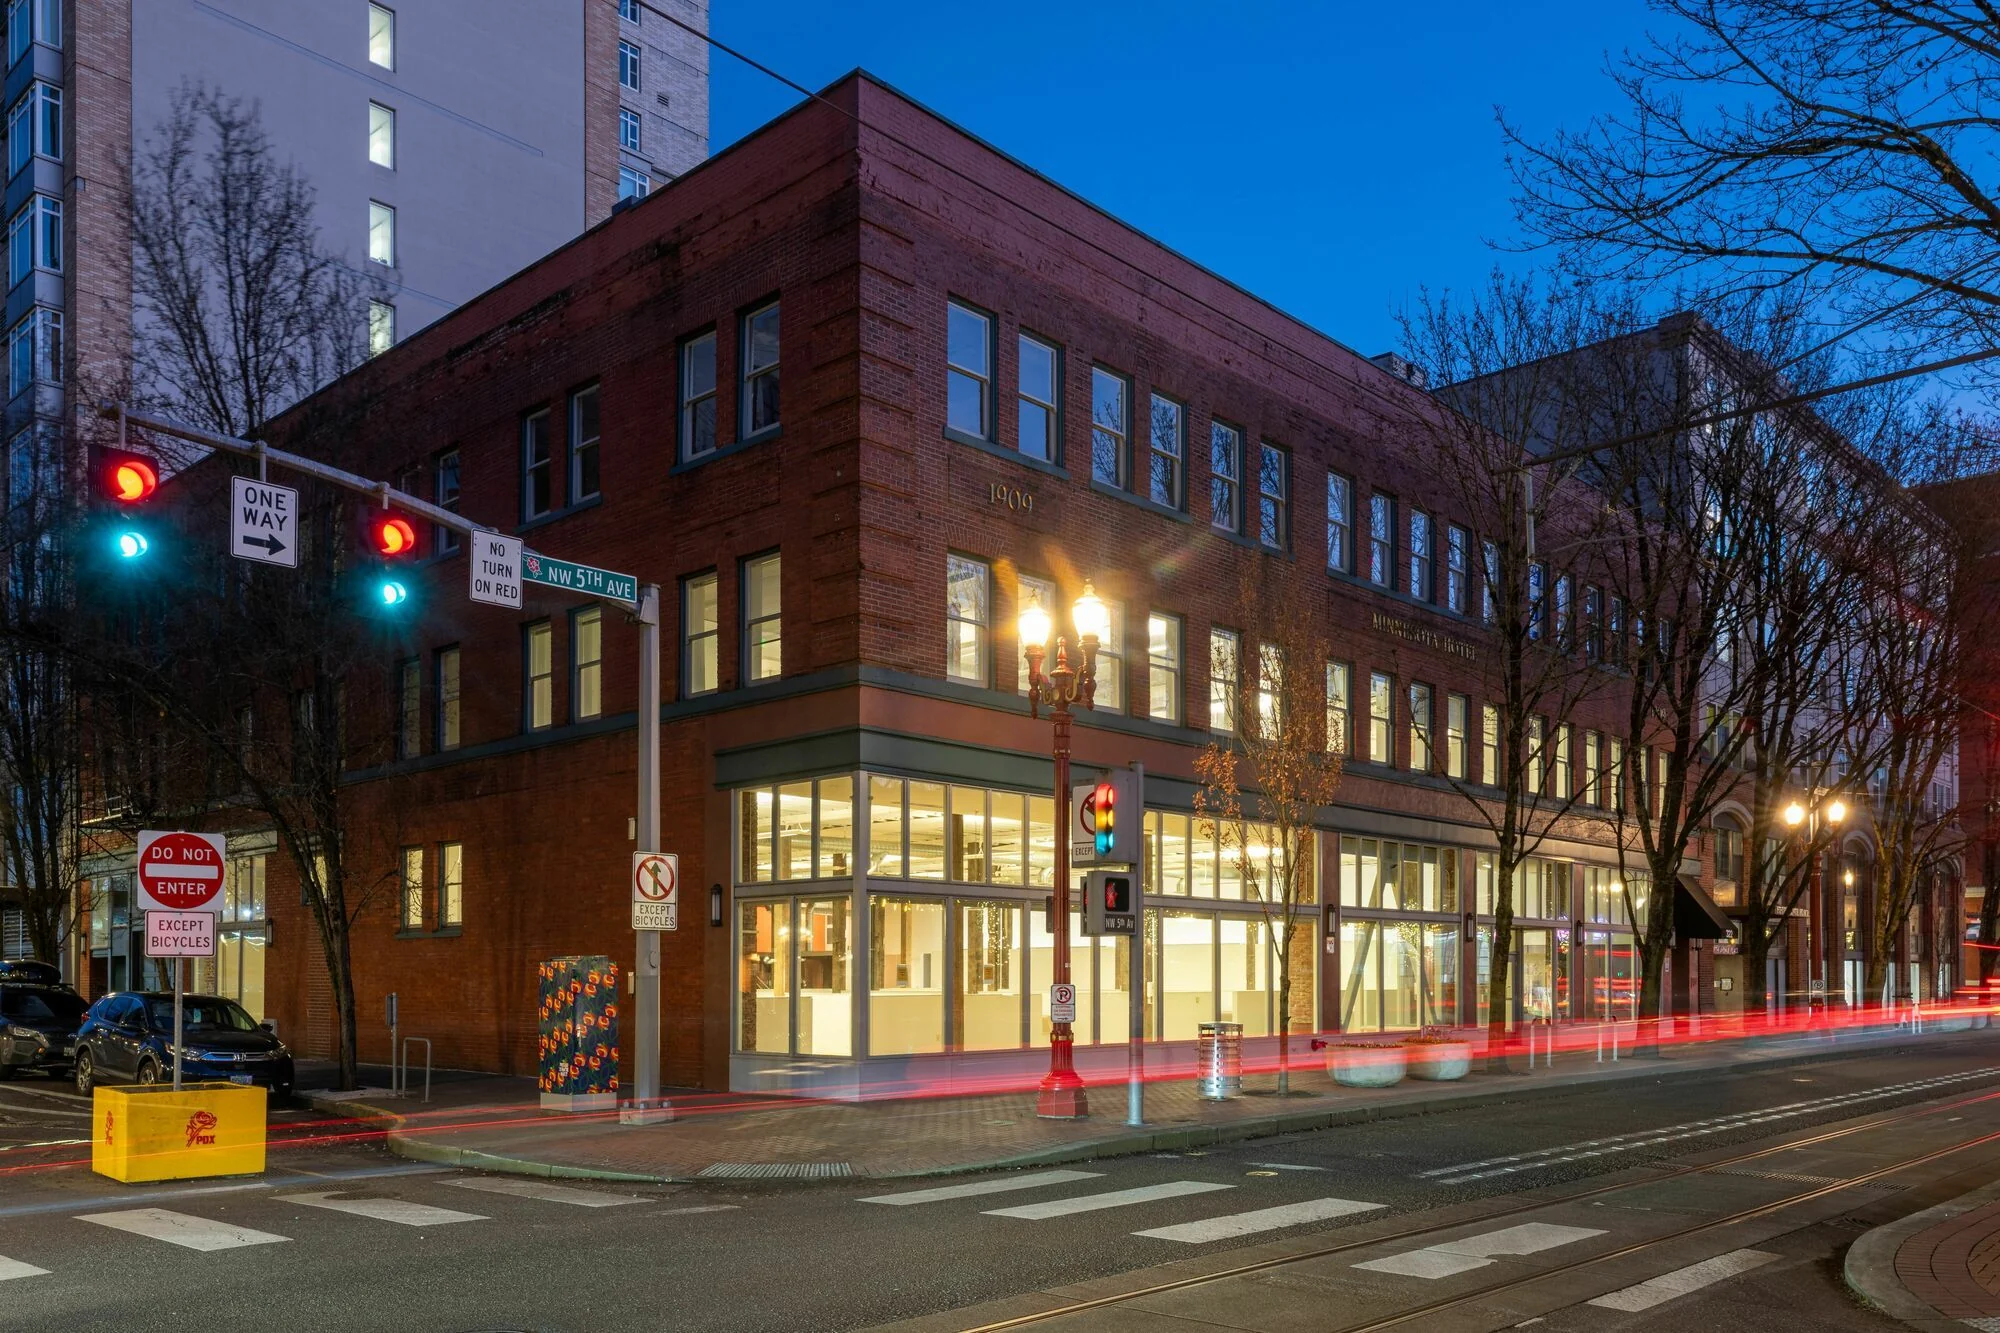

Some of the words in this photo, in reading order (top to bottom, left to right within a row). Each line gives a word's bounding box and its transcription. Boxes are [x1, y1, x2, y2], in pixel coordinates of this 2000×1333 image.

[245, 486, 287, 512] ONE
[990, 483, 1033, 512] 1909
[243, 506, 288, 532] WAY
[489, 541, 506, 558] NO
[482, 559, 513, 579] TURN
[475, 578, 491, 594] ON
[495, 582, 518, 600] RED
[548, 566, 572, 586] NW
[576, 568, 603, 589] 5TH
[606, 579, 631, 599] AVE
[152, 846, 174, 860] DO
[183, 848, 213, 861] NOT
[1075, 846, 1093, 856] EXCEPT
[157, 881, 207, 896] ENTER
[639, 904, 671, 916] EXCEPT
[158, 919, 205, 932] EXCEPT
[635, 915, 675, 927] BICYCLES
[1105, 917, 1116, 929] NW
[151, 935, 210, 949] BICYCLES
[196, 1135, 216, 1145] PDX
